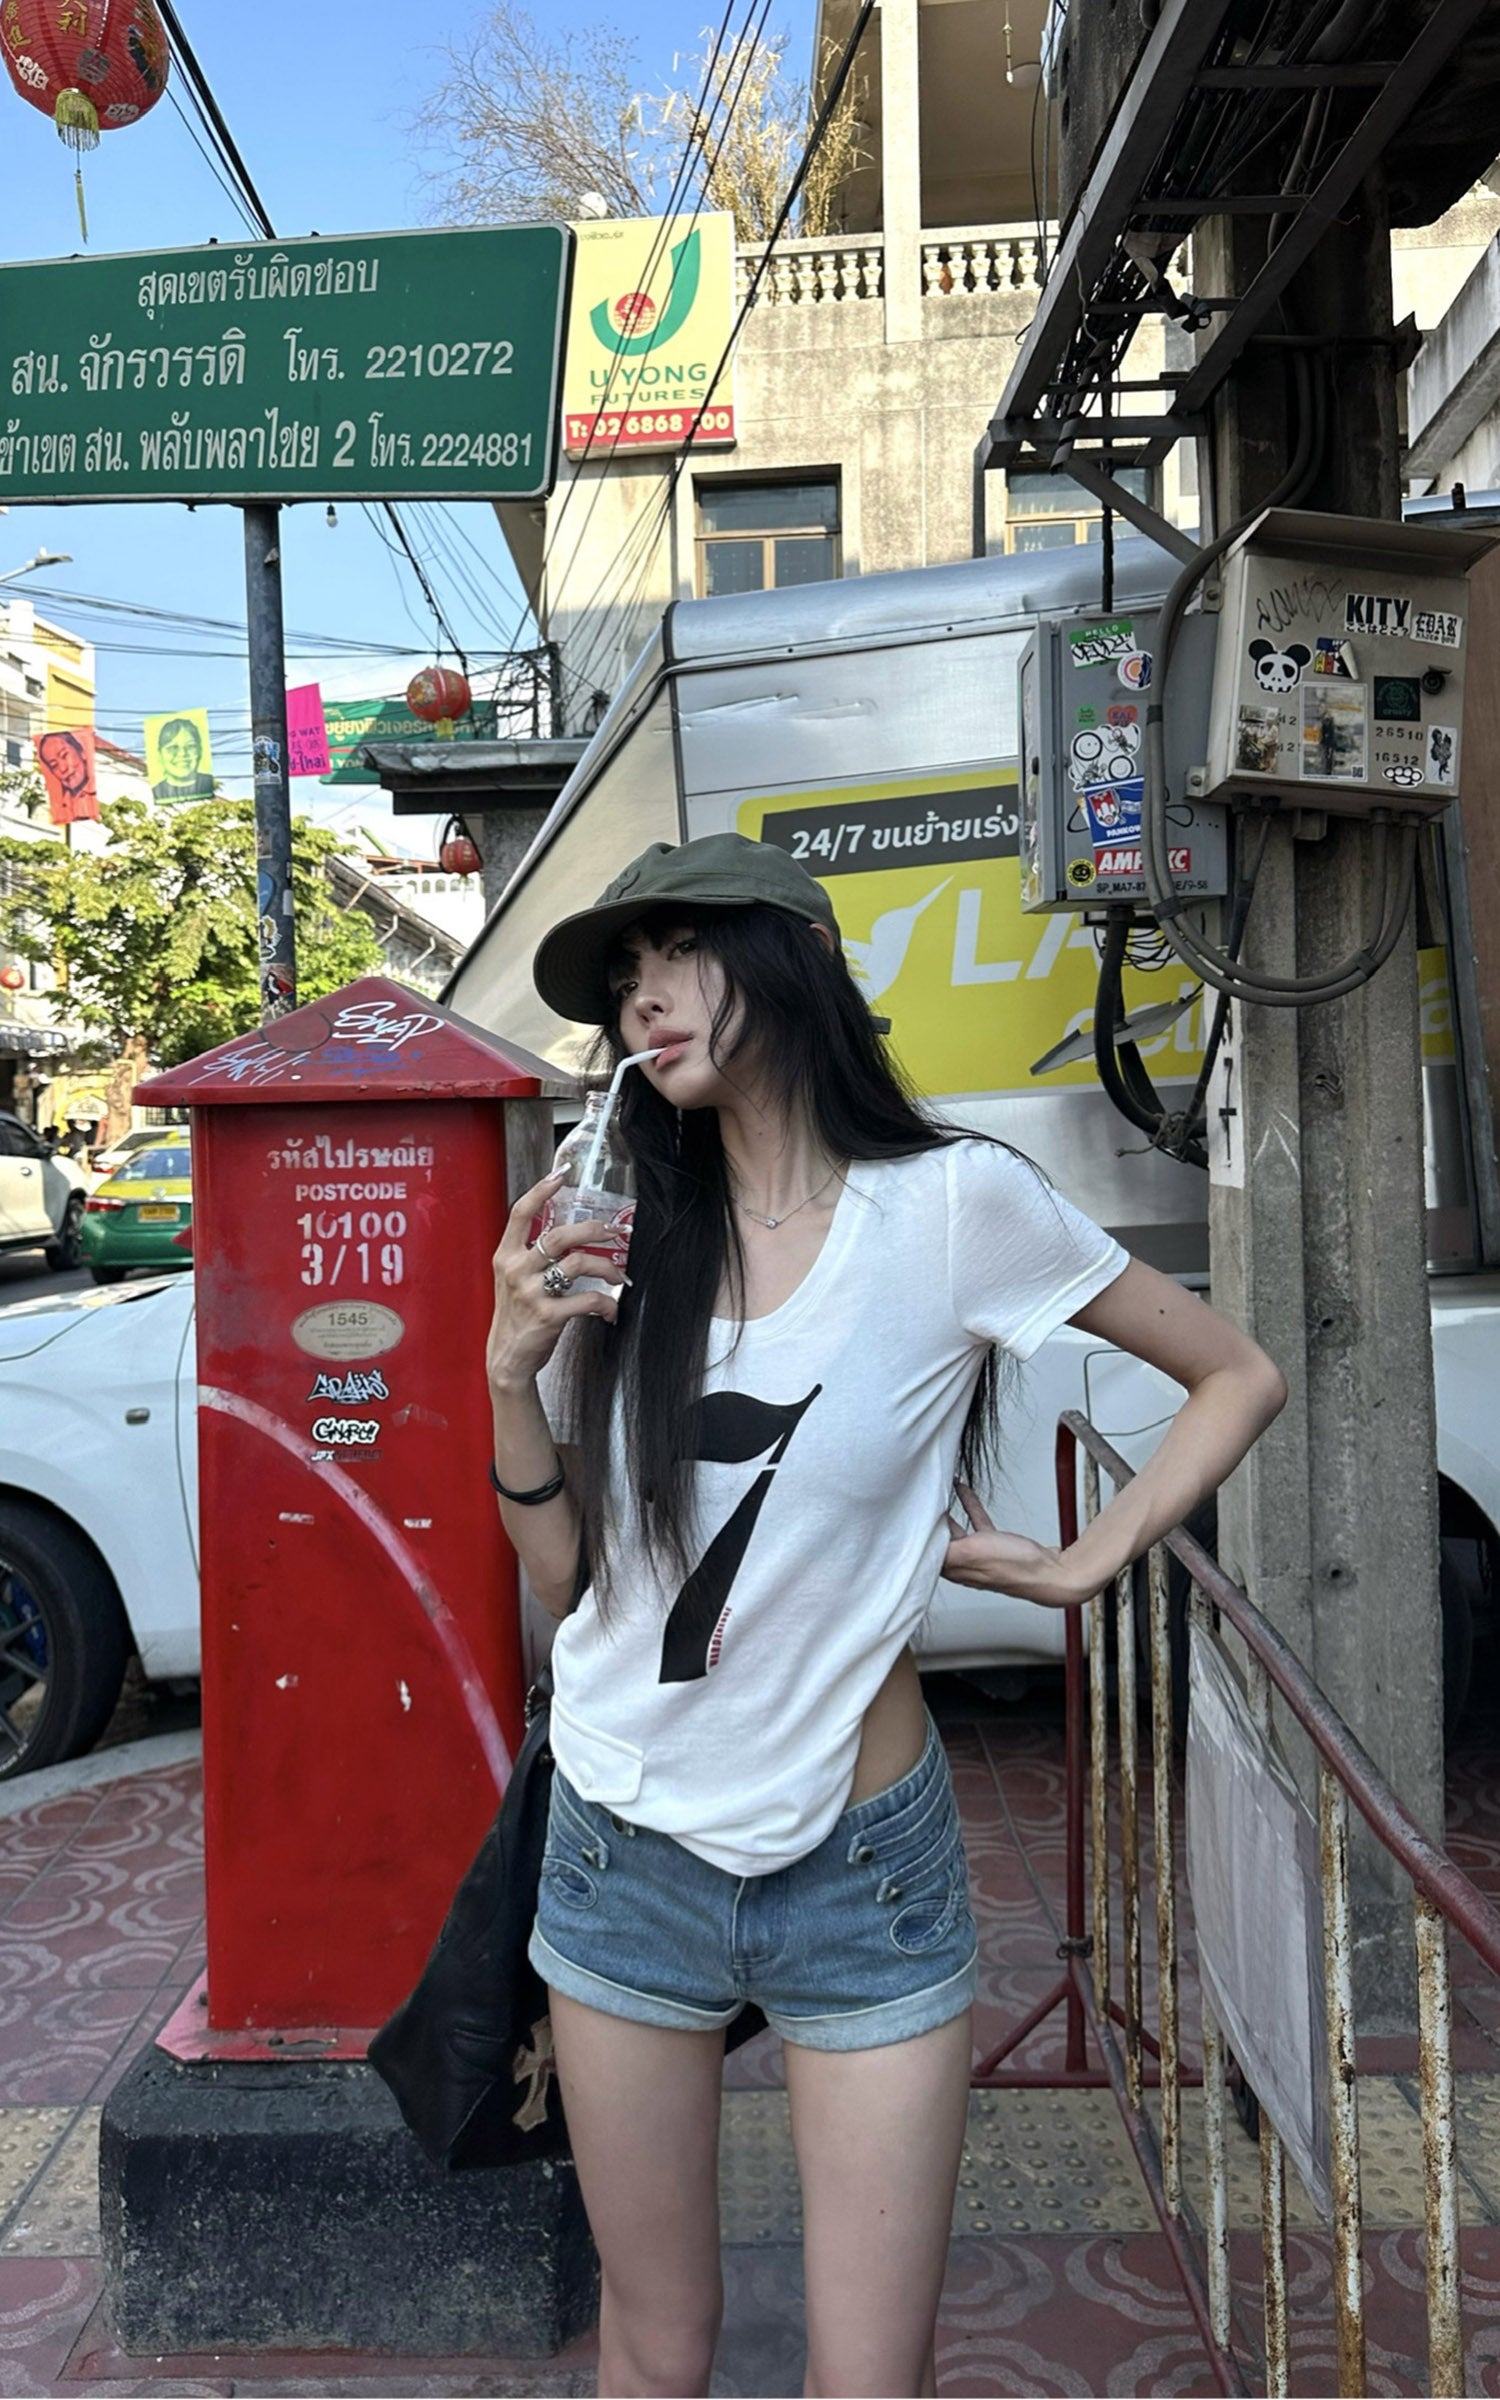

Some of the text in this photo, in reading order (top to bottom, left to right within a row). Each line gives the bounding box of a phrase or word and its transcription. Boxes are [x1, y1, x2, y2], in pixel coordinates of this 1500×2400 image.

[138, 253, 379, 320] สุดเขตรับผิดชอบ
[11, 327, 514, 395] สน. จักรวรรดิ โทร. 2210272
[621, 363, 707, 386] YONG
[591, 388, 706, 405] FUTURES
[84, 426, 130, 472] สน.
[140, 406, 320, 471] พลับพลาไชย
[332, 420, 356, 468] 2
[626, 413, 683, 435] 6868
[1346, 594, 1411, 627] KITY
[1085, 624, 1119, 637] HELLO
[791, 804, 1019, 862] 24/7 ขนย้ายเร่ง
[296, 1182, 407, 1202] POSTCODE
[297, 1210, 407, 1240] 10100
[301, 1242, 403, 1286] 3/19
[328, 1312, 368, 1326] 1545
